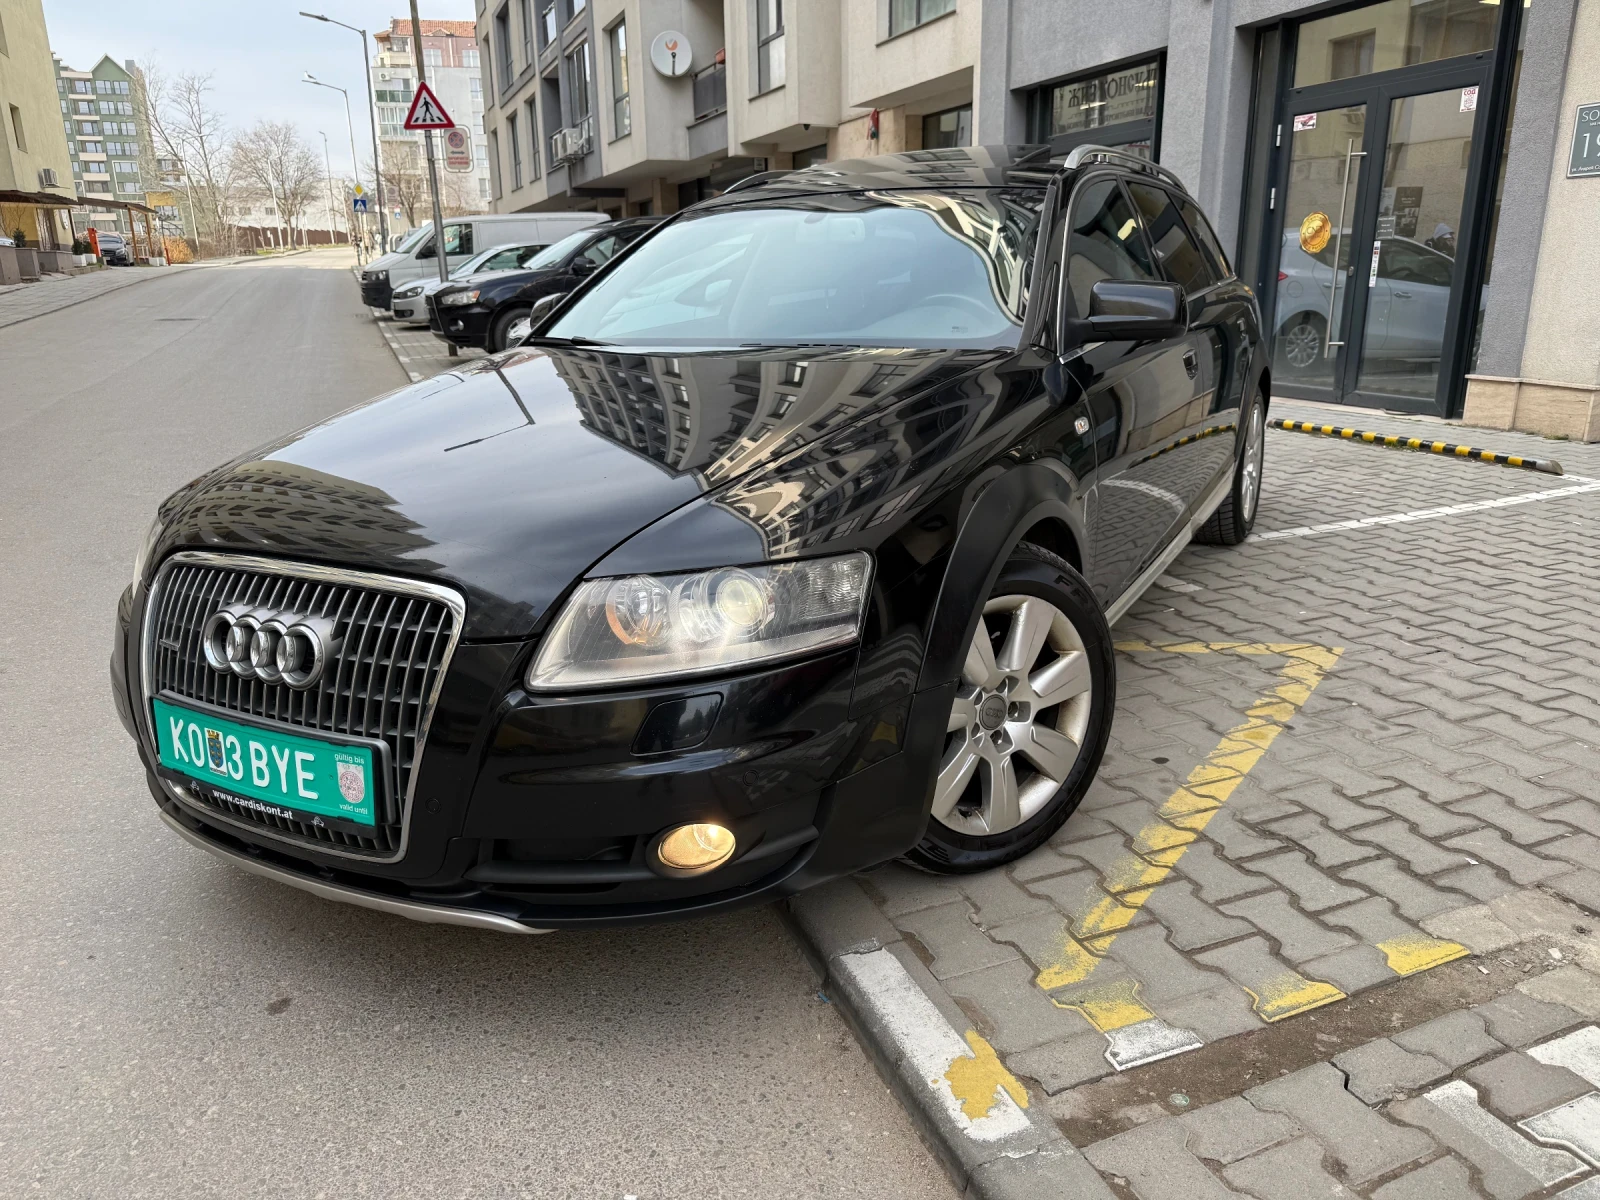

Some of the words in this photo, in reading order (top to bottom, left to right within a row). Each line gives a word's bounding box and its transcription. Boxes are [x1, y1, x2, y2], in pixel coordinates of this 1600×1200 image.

[335, 752, 353, 764] gültig
[354, 756, 365, 764] bis
[212, 789, 294, 820] www.cardiskont.at
[339, 803, 353, 812] valid
[354, 807, 368, 815] until
